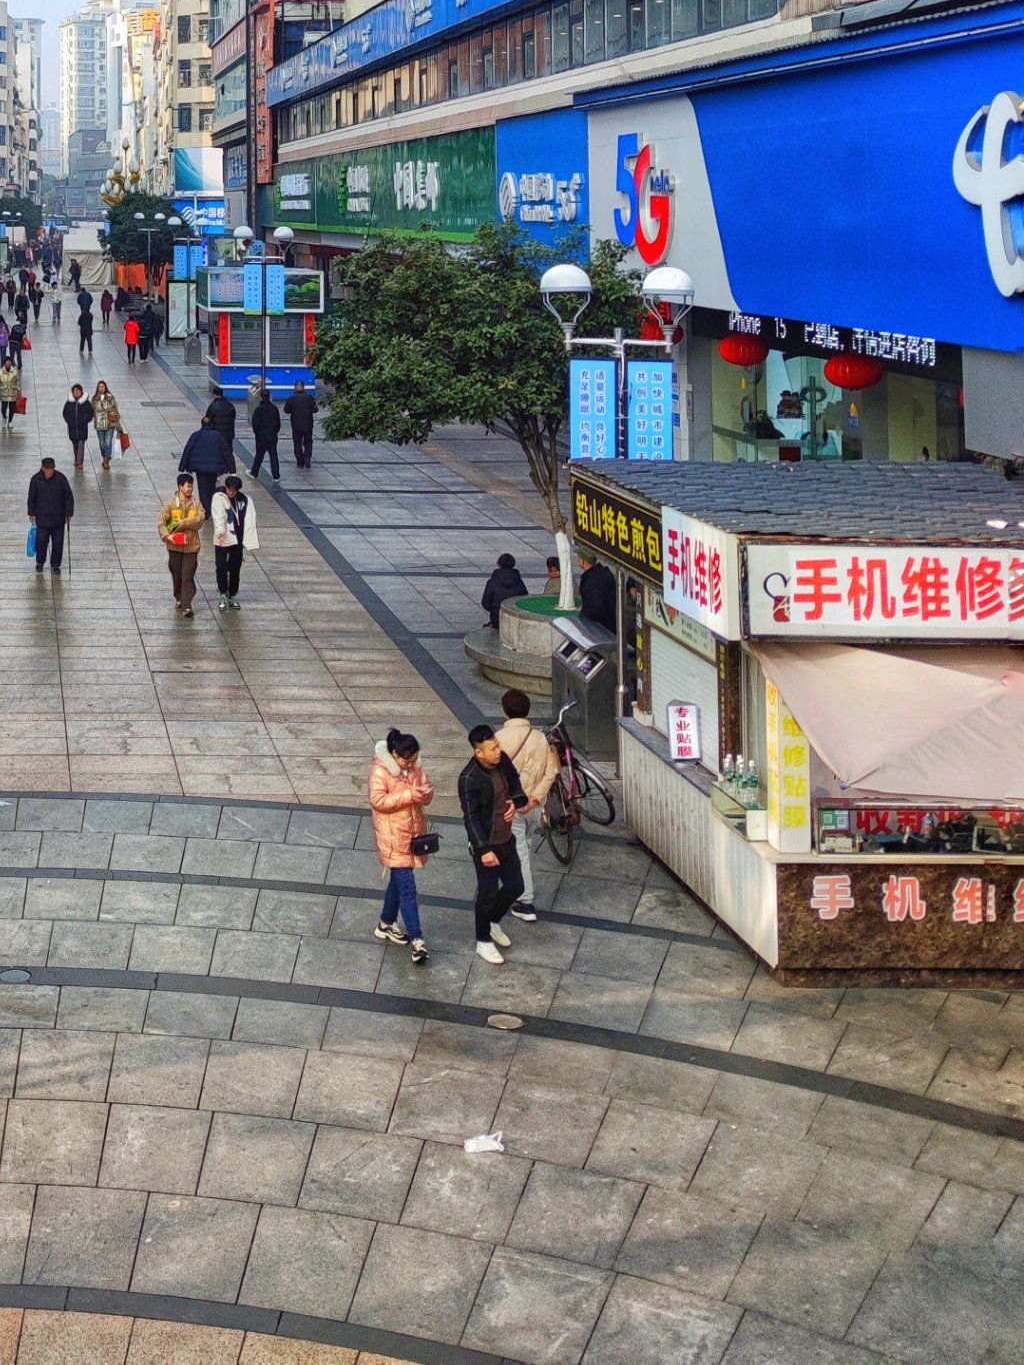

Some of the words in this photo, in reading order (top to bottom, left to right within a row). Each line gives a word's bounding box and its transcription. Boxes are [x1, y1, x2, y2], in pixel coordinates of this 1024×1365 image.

[519, 173, 555, 202] 中国移动
[613, 133, 676, 267] 5G
[729, 312, 761, 335] iPhone
[774, 317, 787, 339] 15
[576, 489, 663, 572] 铅山特色煎包
[668, 528, 723, 615] 手机维修
[675, 706, 693, 757] 专业贴膜
[782, 710, 807, 828] 维修贴膜
